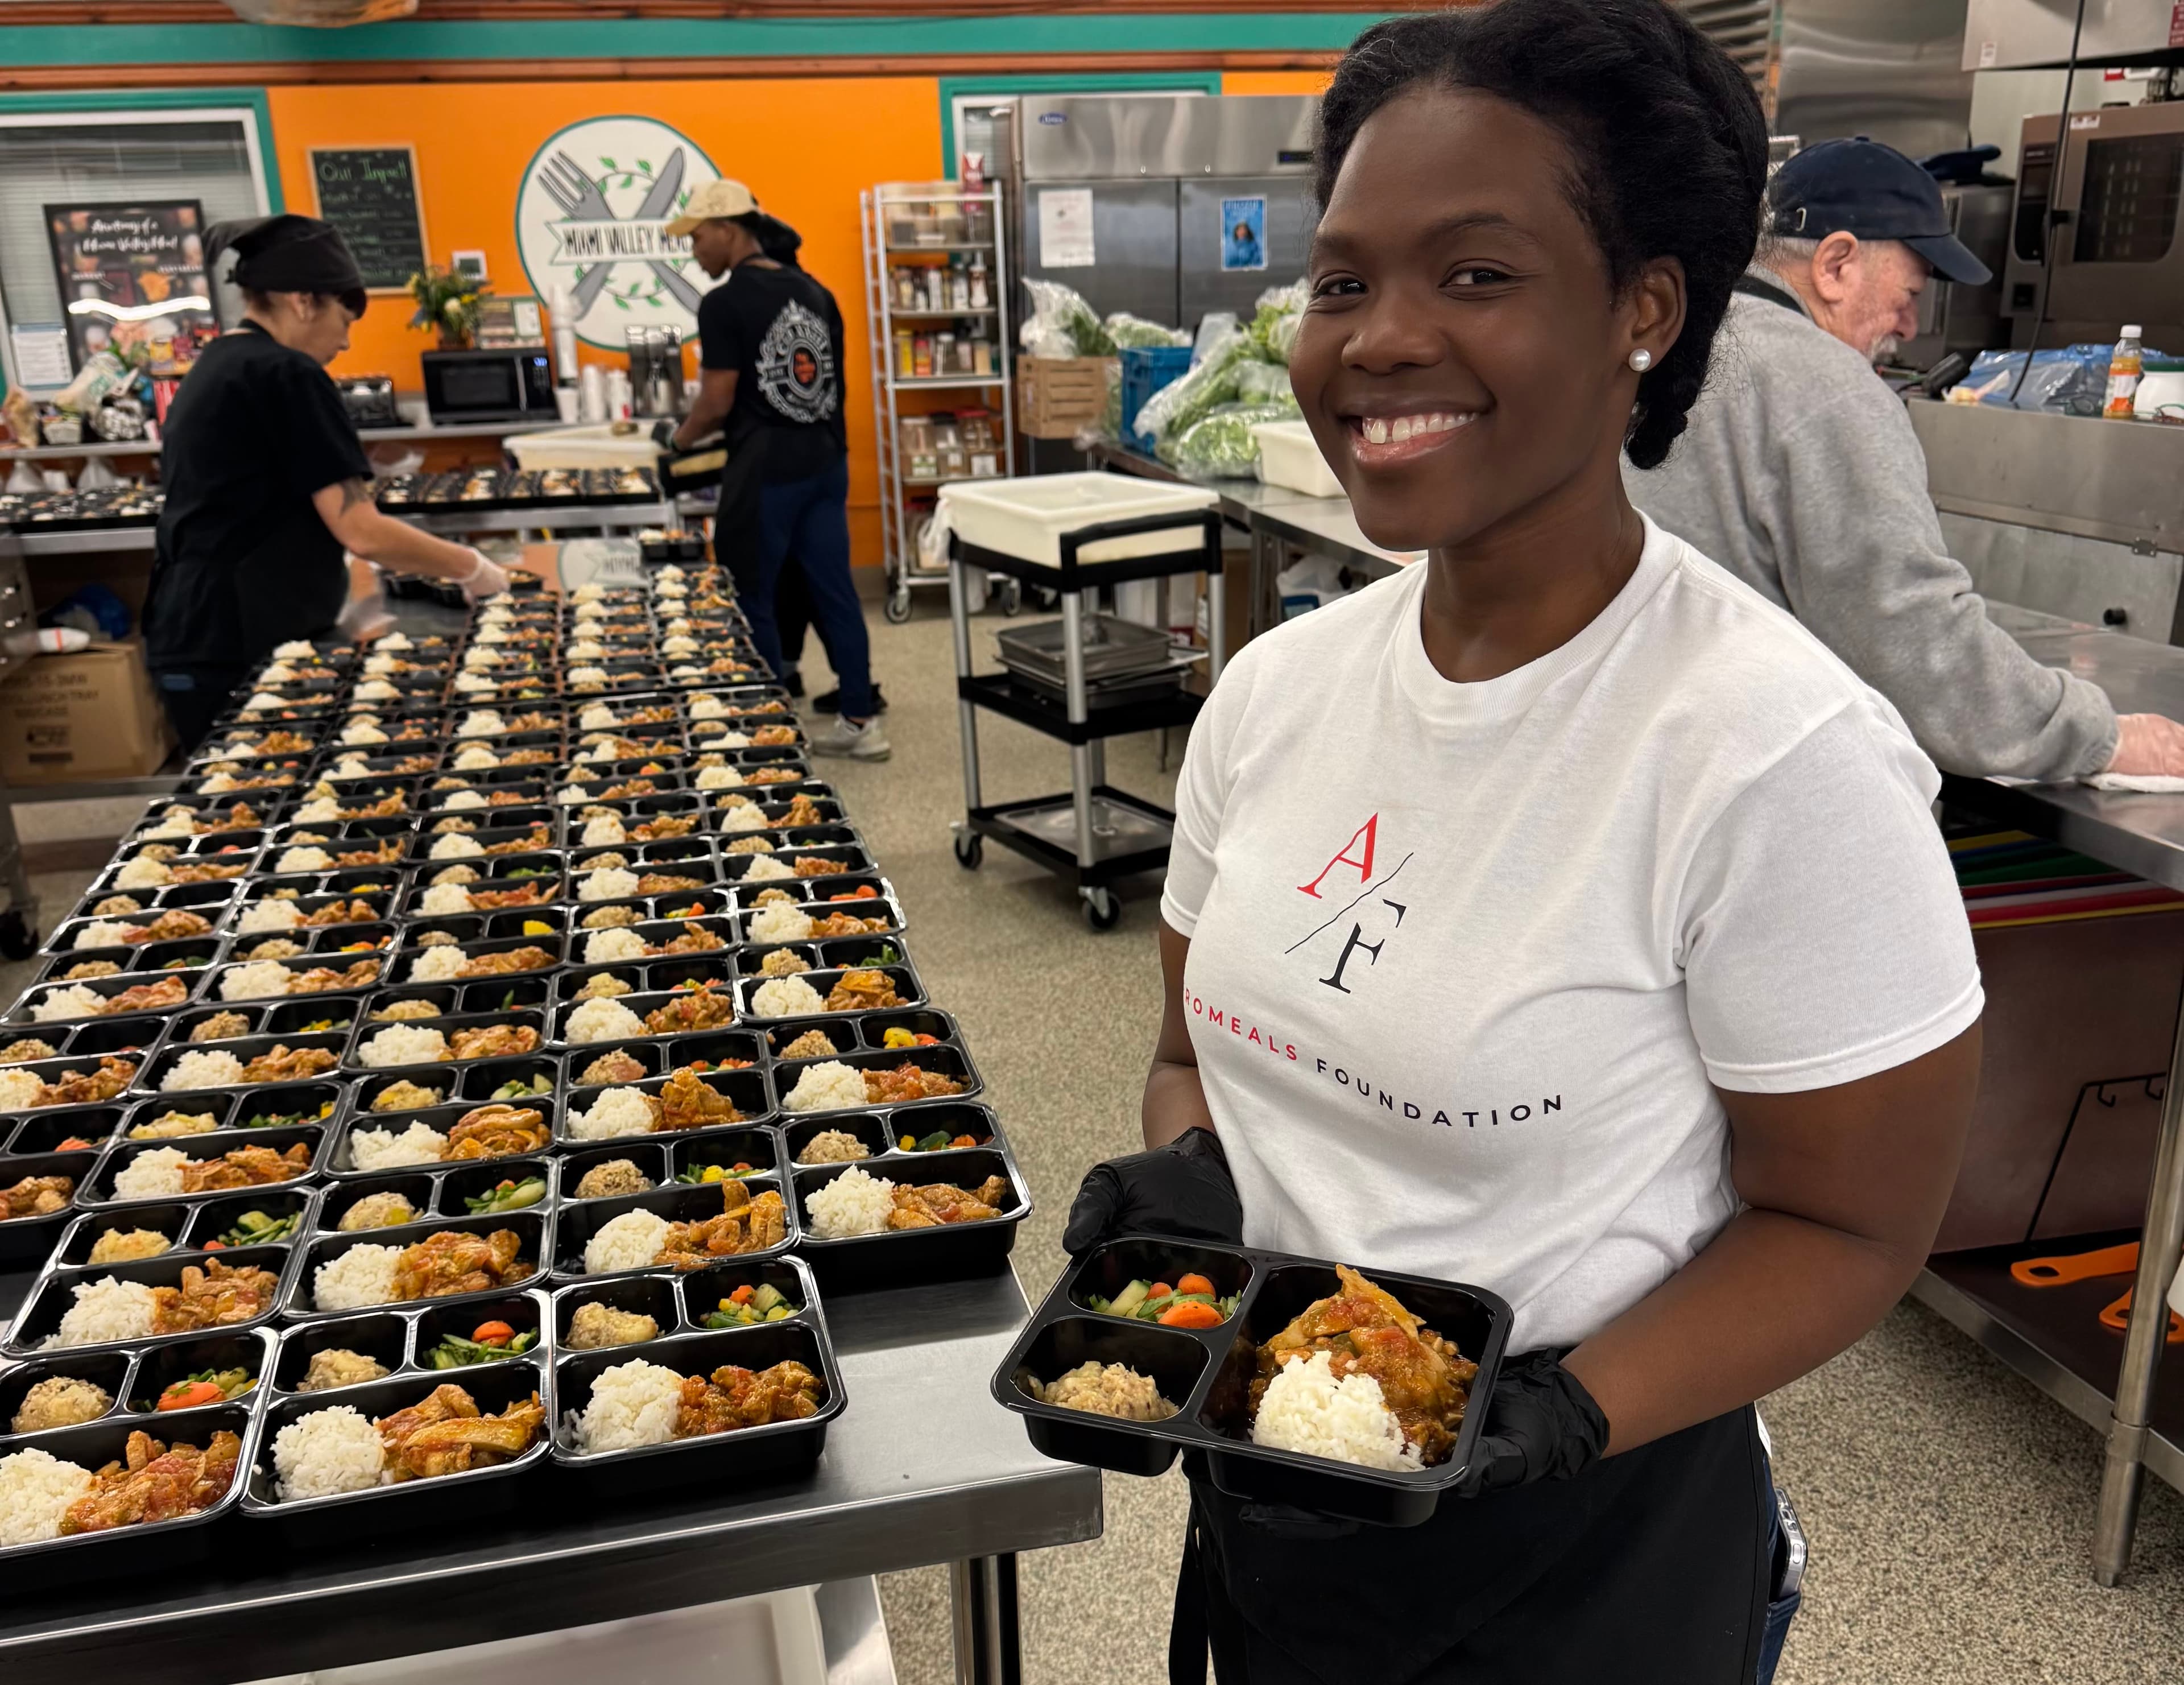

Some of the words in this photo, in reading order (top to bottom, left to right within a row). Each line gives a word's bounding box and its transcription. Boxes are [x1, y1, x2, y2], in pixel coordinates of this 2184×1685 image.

[562, 226, 604, 256] MIAMI
[603, 225, 654, 255] VALLEY
[1297, 812, 1378, 899] A
[1318, 898, 1407, 994] F
[1185, 987, 1297, 1061] ROMEALS
[1316, 1058, 1562, 1128] FOUNDATION
